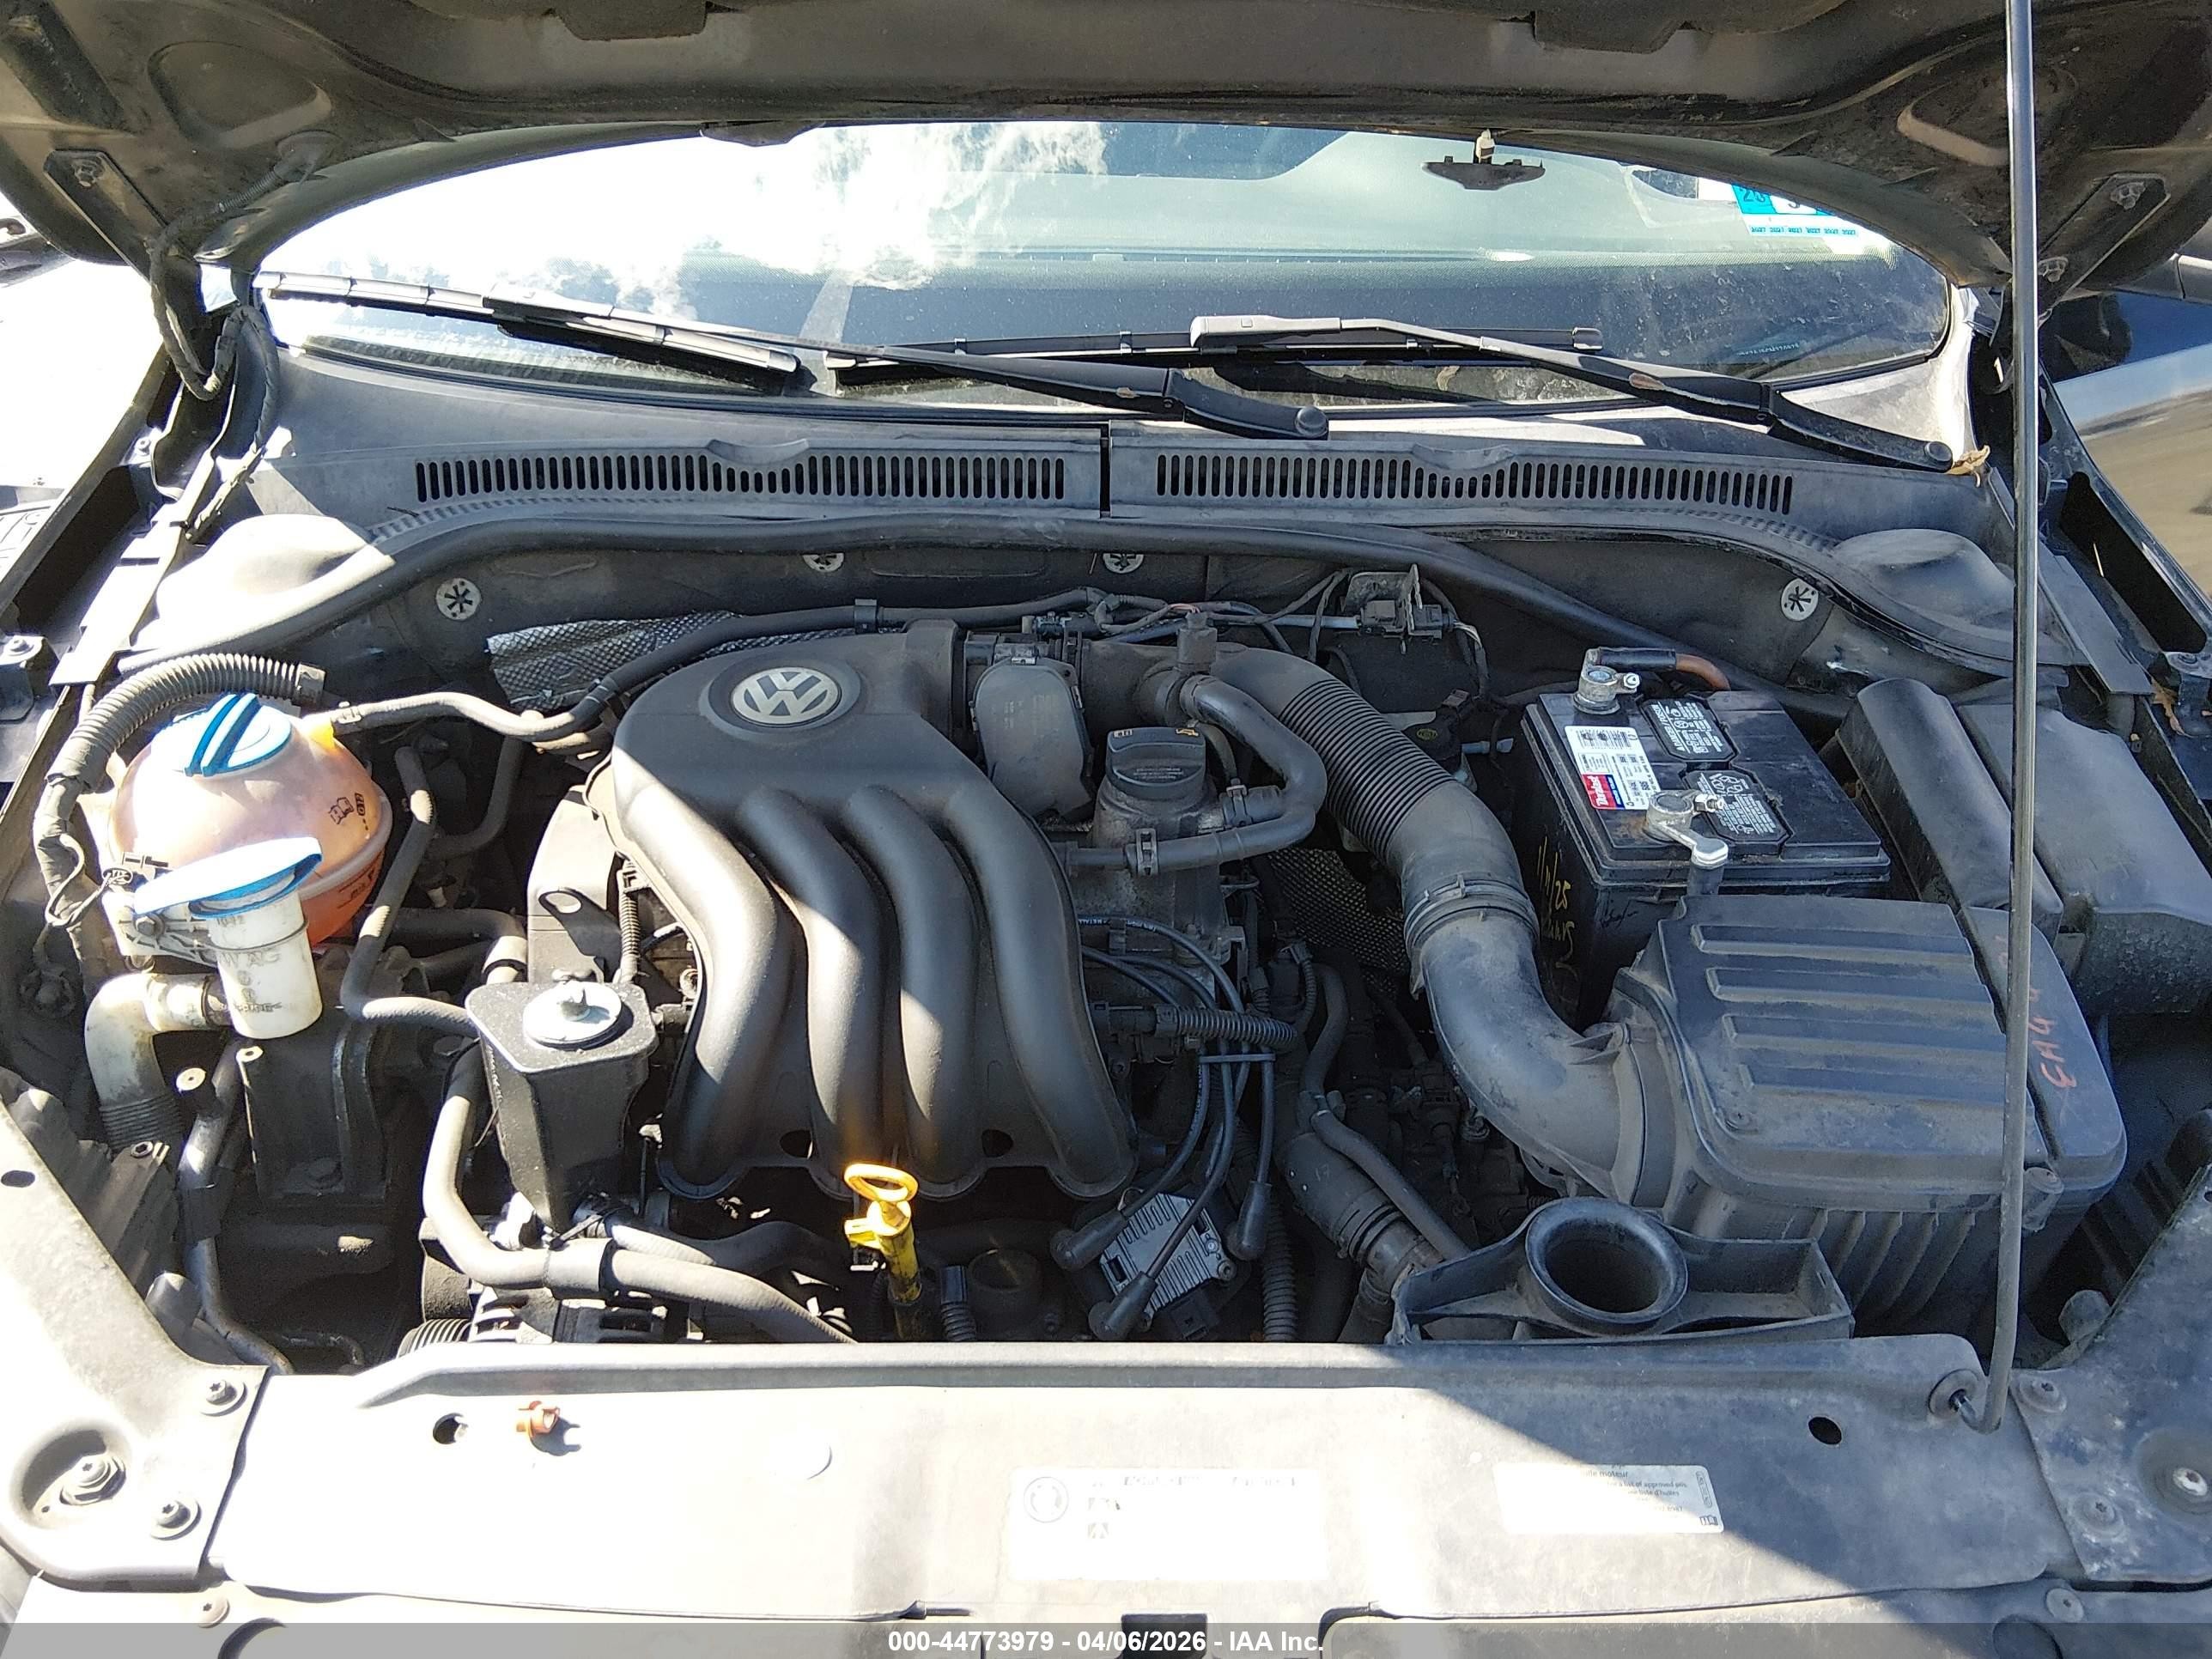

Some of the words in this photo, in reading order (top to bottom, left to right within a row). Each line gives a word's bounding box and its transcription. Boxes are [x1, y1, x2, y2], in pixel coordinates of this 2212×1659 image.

[732, 666, 839, 725] VW
[1586, 775, 1608, 805] Duralast
[1644, 1480, 1674, 1488] approved
